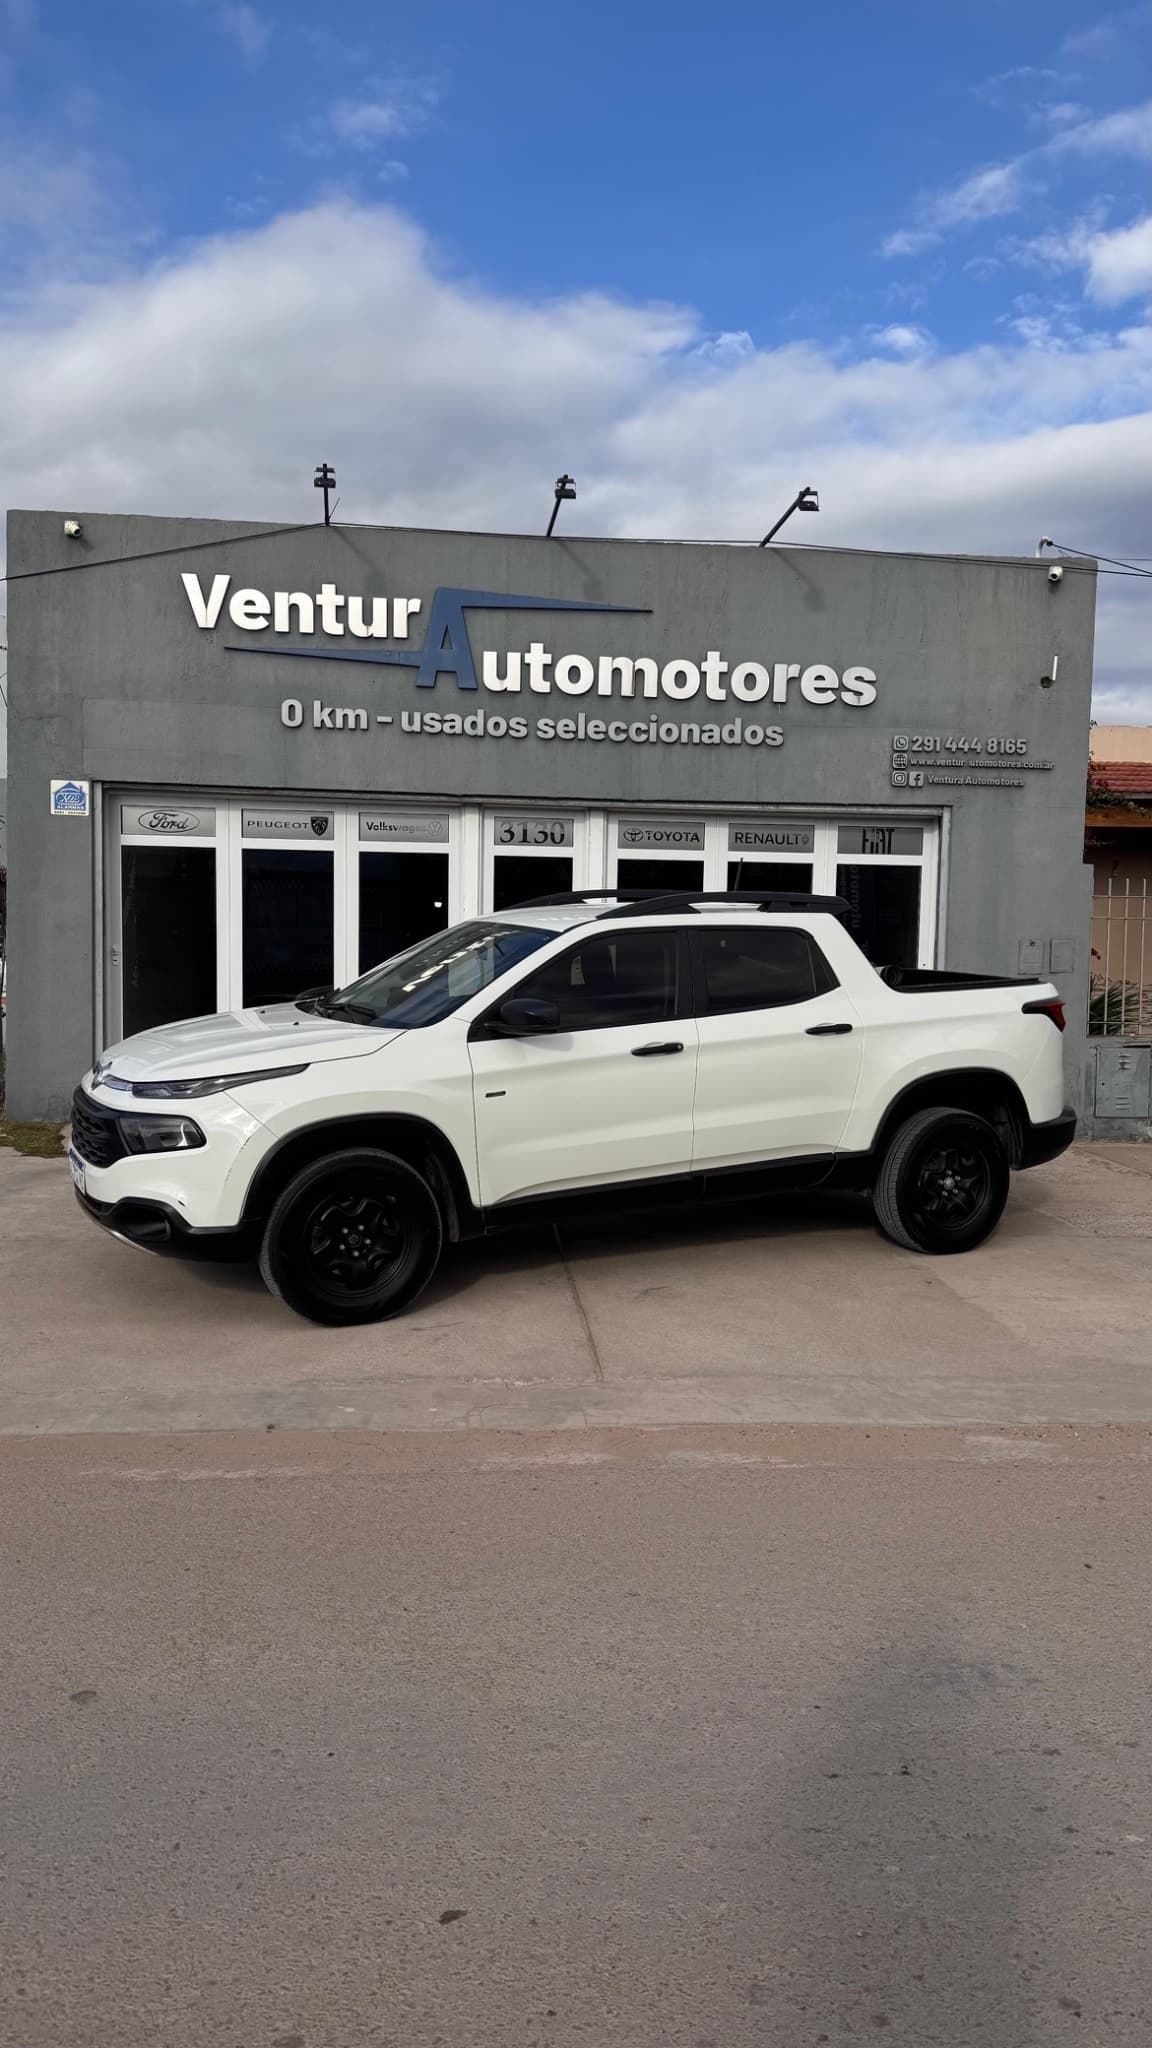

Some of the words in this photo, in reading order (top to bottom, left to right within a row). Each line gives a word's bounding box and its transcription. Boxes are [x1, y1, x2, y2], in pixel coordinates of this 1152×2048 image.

[281, 698, 303, 727] 0
[313, 700, 368, 729] km
[401, 709, 528, 737] usados
[536, 712, 784, 745] seleccionados
[911, 735, 941, 752] 291
[944, 736, 982, 753] 444
[986, 737, 1028, 755] 8165
[928, 775, 963, 785] Ventura
[965, 776, 1025, 788] Automotores
[148, 811, 189, 831] Ford
[247, 820, 310, 830] PEUGEOT
[499, 821, 566, 845] 3130
[645, 829, 700, 843] TOYOTA
[735, 831, 801, 846] RENAULT
